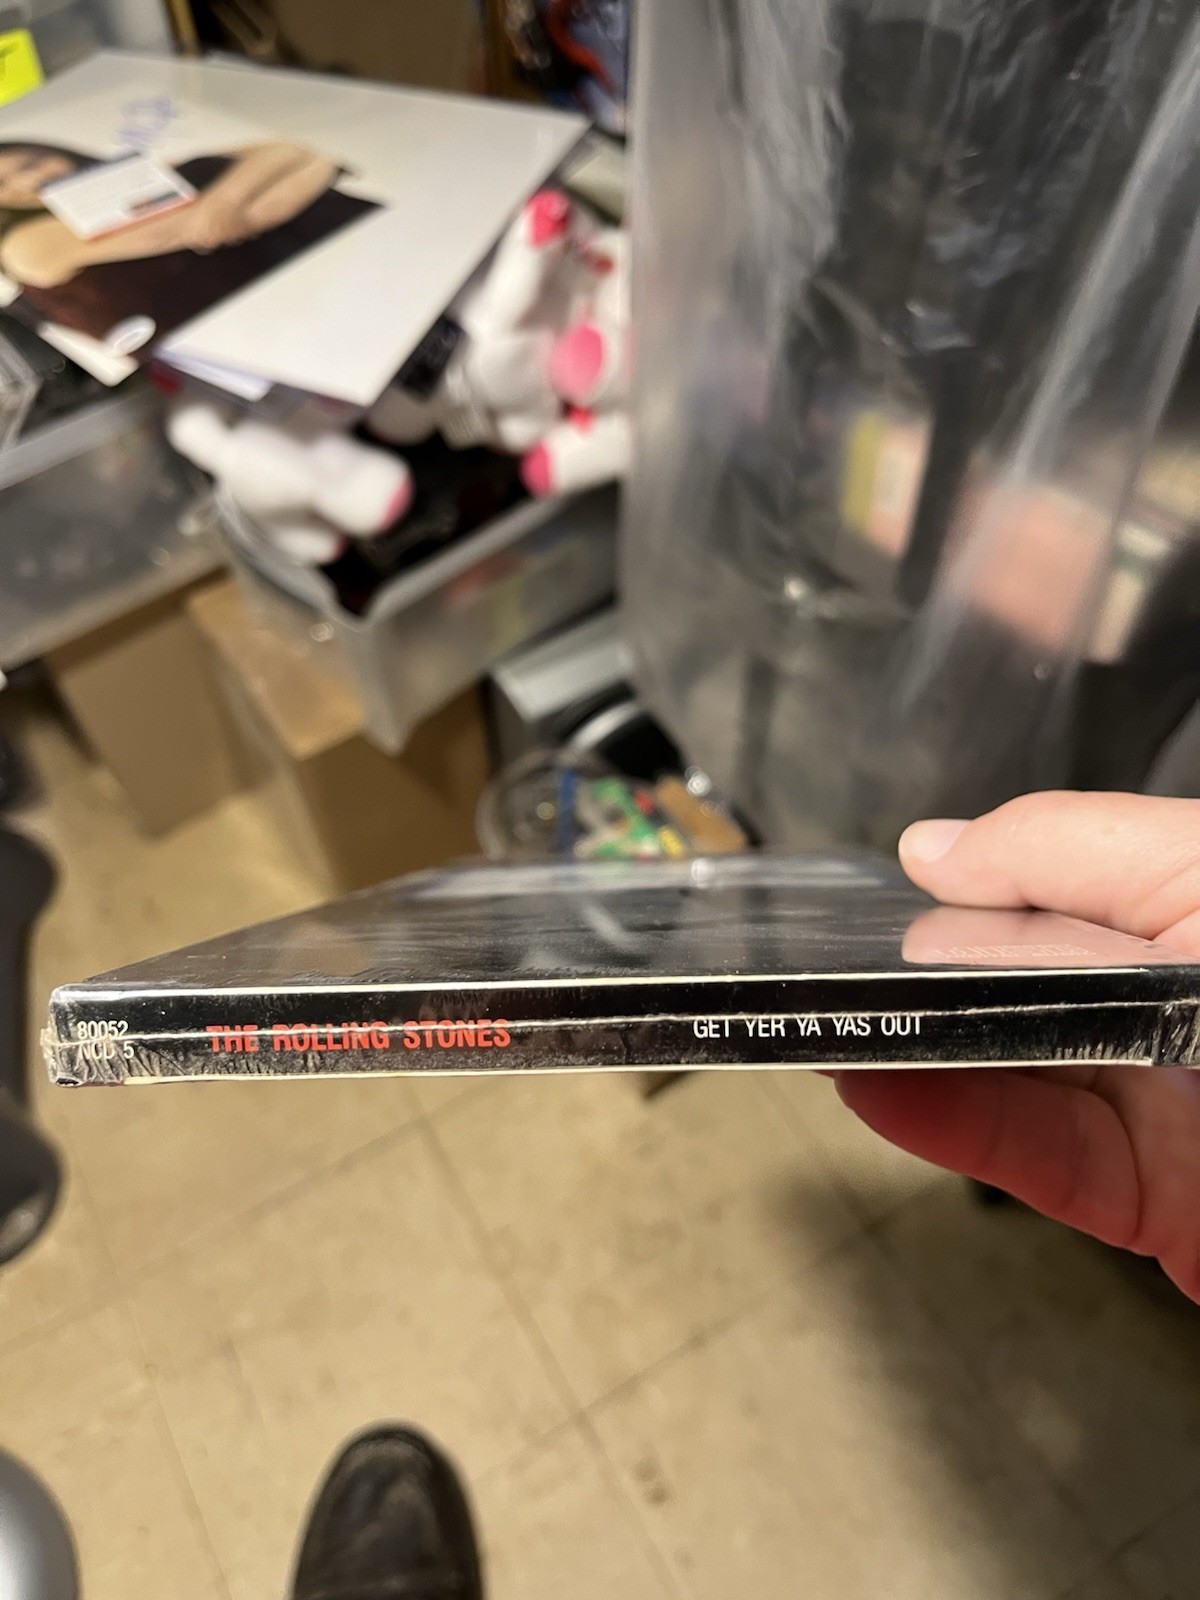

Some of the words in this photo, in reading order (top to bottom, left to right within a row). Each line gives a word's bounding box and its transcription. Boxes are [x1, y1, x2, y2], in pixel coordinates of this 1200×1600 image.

[77, 1020, 128, 1040] 80052
[206, 1024, 259, 1053] THE
[271, 1020, 391, 1052] ROLLING
[403, 1018, 512, 1049] STONES
[693, 1016, 732, 1039] GET
[745, 1016, 786, 1038] YER
[796, 1015, 822, 1037] YA
[831, 1014, 871, 1037] YAS
[880, 1013, 924, 1037] OUT
[123, 1040, 135, 1059] 5
